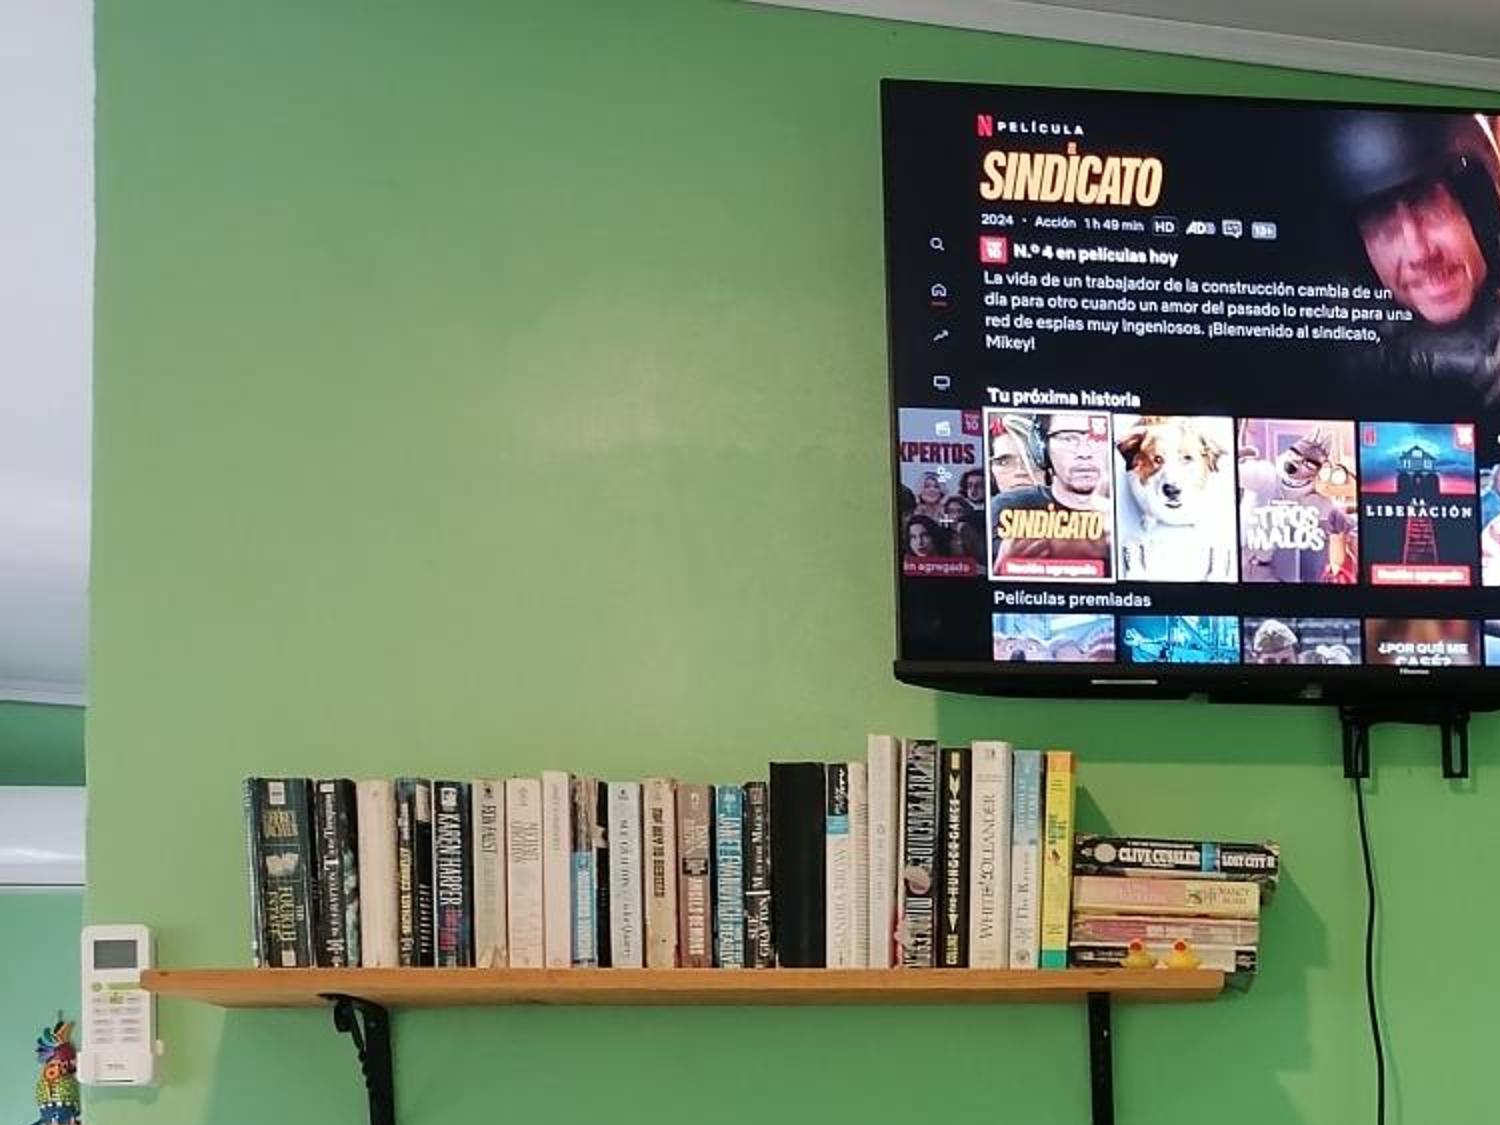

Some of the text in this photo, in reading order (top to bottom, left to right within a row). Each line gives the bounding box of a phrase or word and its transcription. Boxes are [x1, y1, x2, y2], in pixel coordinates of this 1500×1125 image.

[997, 119, 1084, 135] PELÍCULA
[979, 141, 1164, 207] SINDICATO
[981, 213, 1014, 226] 2024
[1034, 216, 1078, 230] Acción
[1092, 217, 1100, 230] h
[1102, 218, 1120, 231] 49
[1121, 219, 1144, 232] min
[1154, 222, 1175, 233] HD
[1041, 245, 1054, 259] 4
[1055, 248, 1077, 261] en
[1078, 246, 1148, 265] películas
[1149, 249, 1179, 267] hoy
[984, 270, 1393, 300] La vida de un trabajador de la construcción cambia de un
[984, 293, 1413, 322] día para otro cuando un amor del pasado lo recluta para una
[985, 314, 1382, 344] red de espías muy ingeniosos. ¡Bienvenido al sindicato,
[985, 335, 1036, 352] Mikey!
[986, 388, 1141, 407] Tu próxima historia
[998, 504, 1104, 540] SINDICATO
[1365, 503, 1473, 519] LIBERACIÓN
[1248, 526, 1328, 551] MALOS
[993, 590, 1152, 609] Películas premiadas
[1377, 640, 1469, 655] ¿POR QUÉ ME
[437, 813, 462, 854] KAREN
[718, 814, 743, 922] JANET EVANOVICH
[1118, 847, 1201, 866] CLIVE CUSSLER
[1244, 855, 1265, 868] CITY
[439, 858, 463, 906] HARPER
[978, 885, 996, 940] WHITE
[688, 915, 705, 956] DEMONS
[758, 896, 770, 957] GRAFTON
